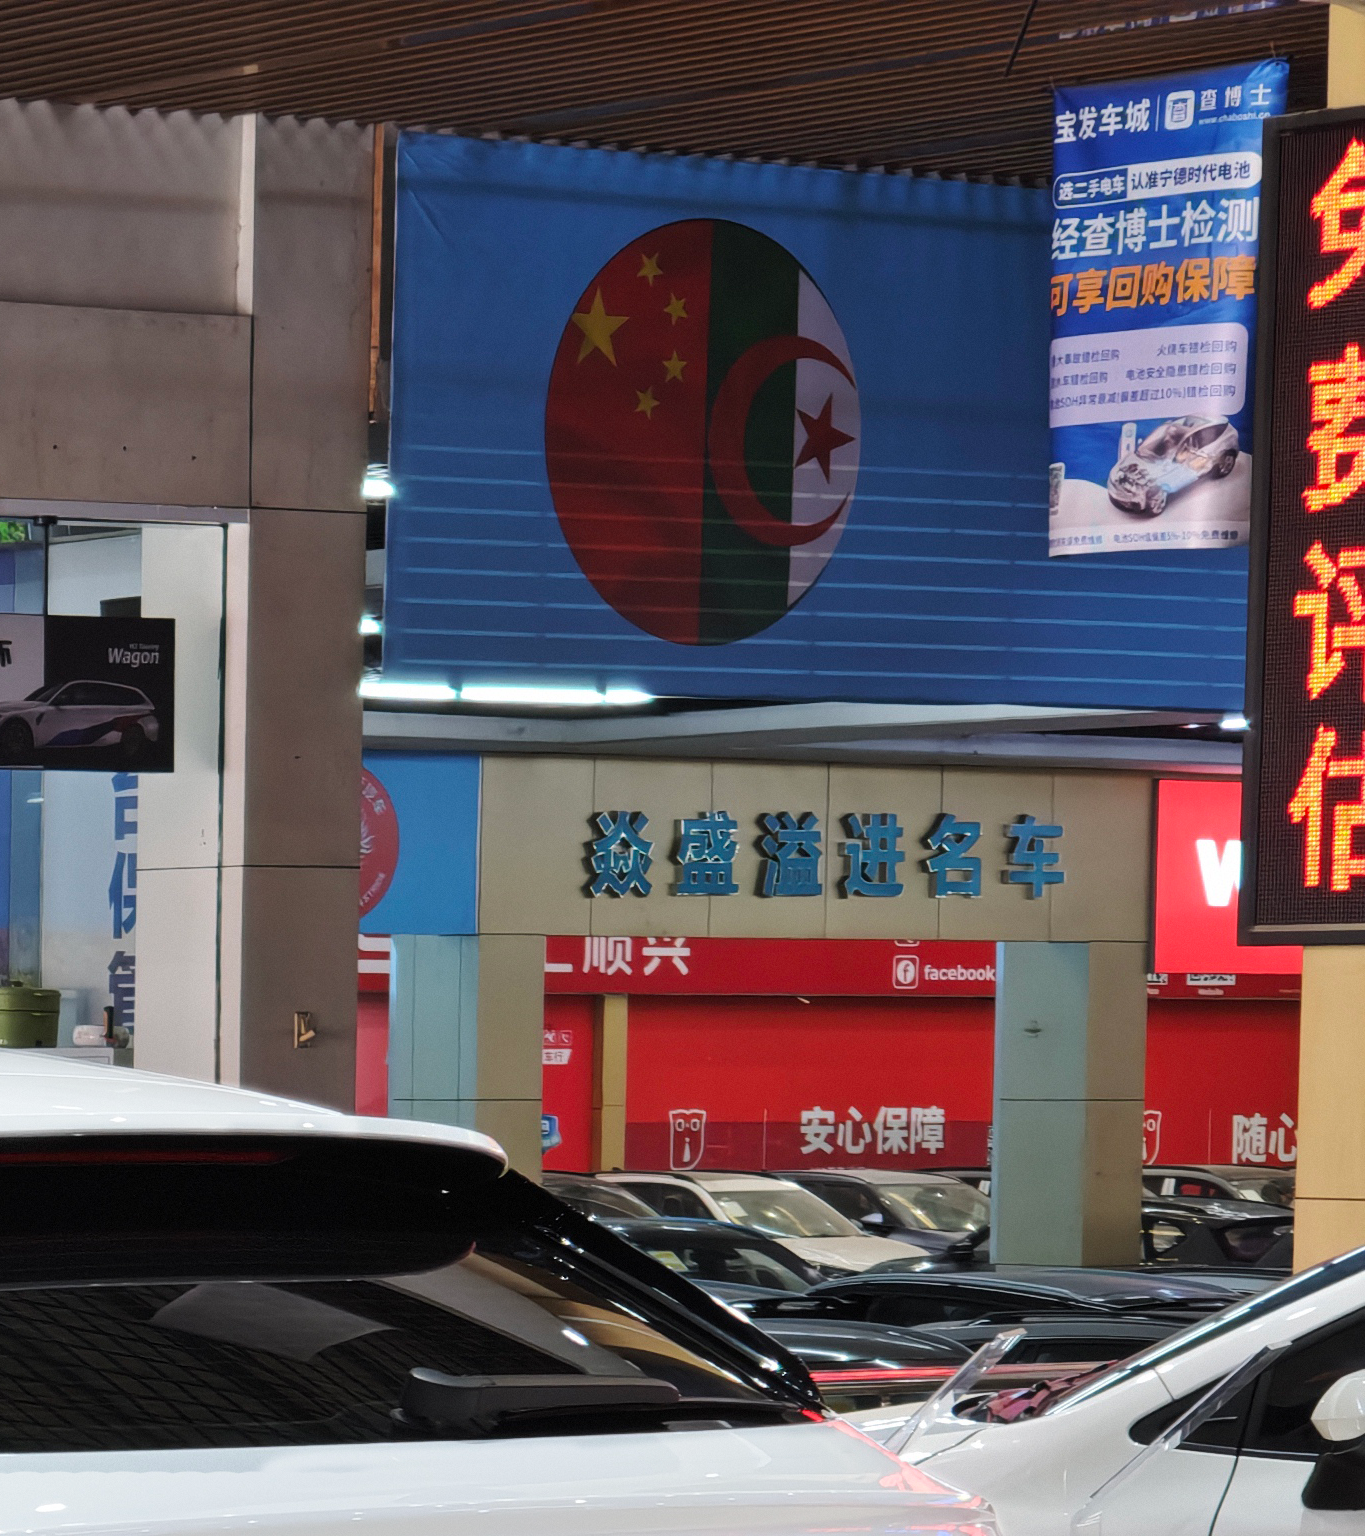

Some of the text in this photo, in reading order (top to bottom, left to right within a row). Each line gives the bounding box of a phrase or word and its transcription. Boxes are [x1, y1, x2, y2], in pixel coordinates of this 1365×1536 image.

[1054, 84, 1272, 144] 宝发车城 查博士
[1059, 160, 1251, 202] 选二手电车 认准宁德时代电池
[1051, 198, 1259, 261] 经查博士检测
[1051, 254, 1256, 317] 可享回购保障
[108, 647, 161, 668] Wagon
[923, 964, 996, 982] facebook
[799, 1105, 946, 1155] 安心保障
